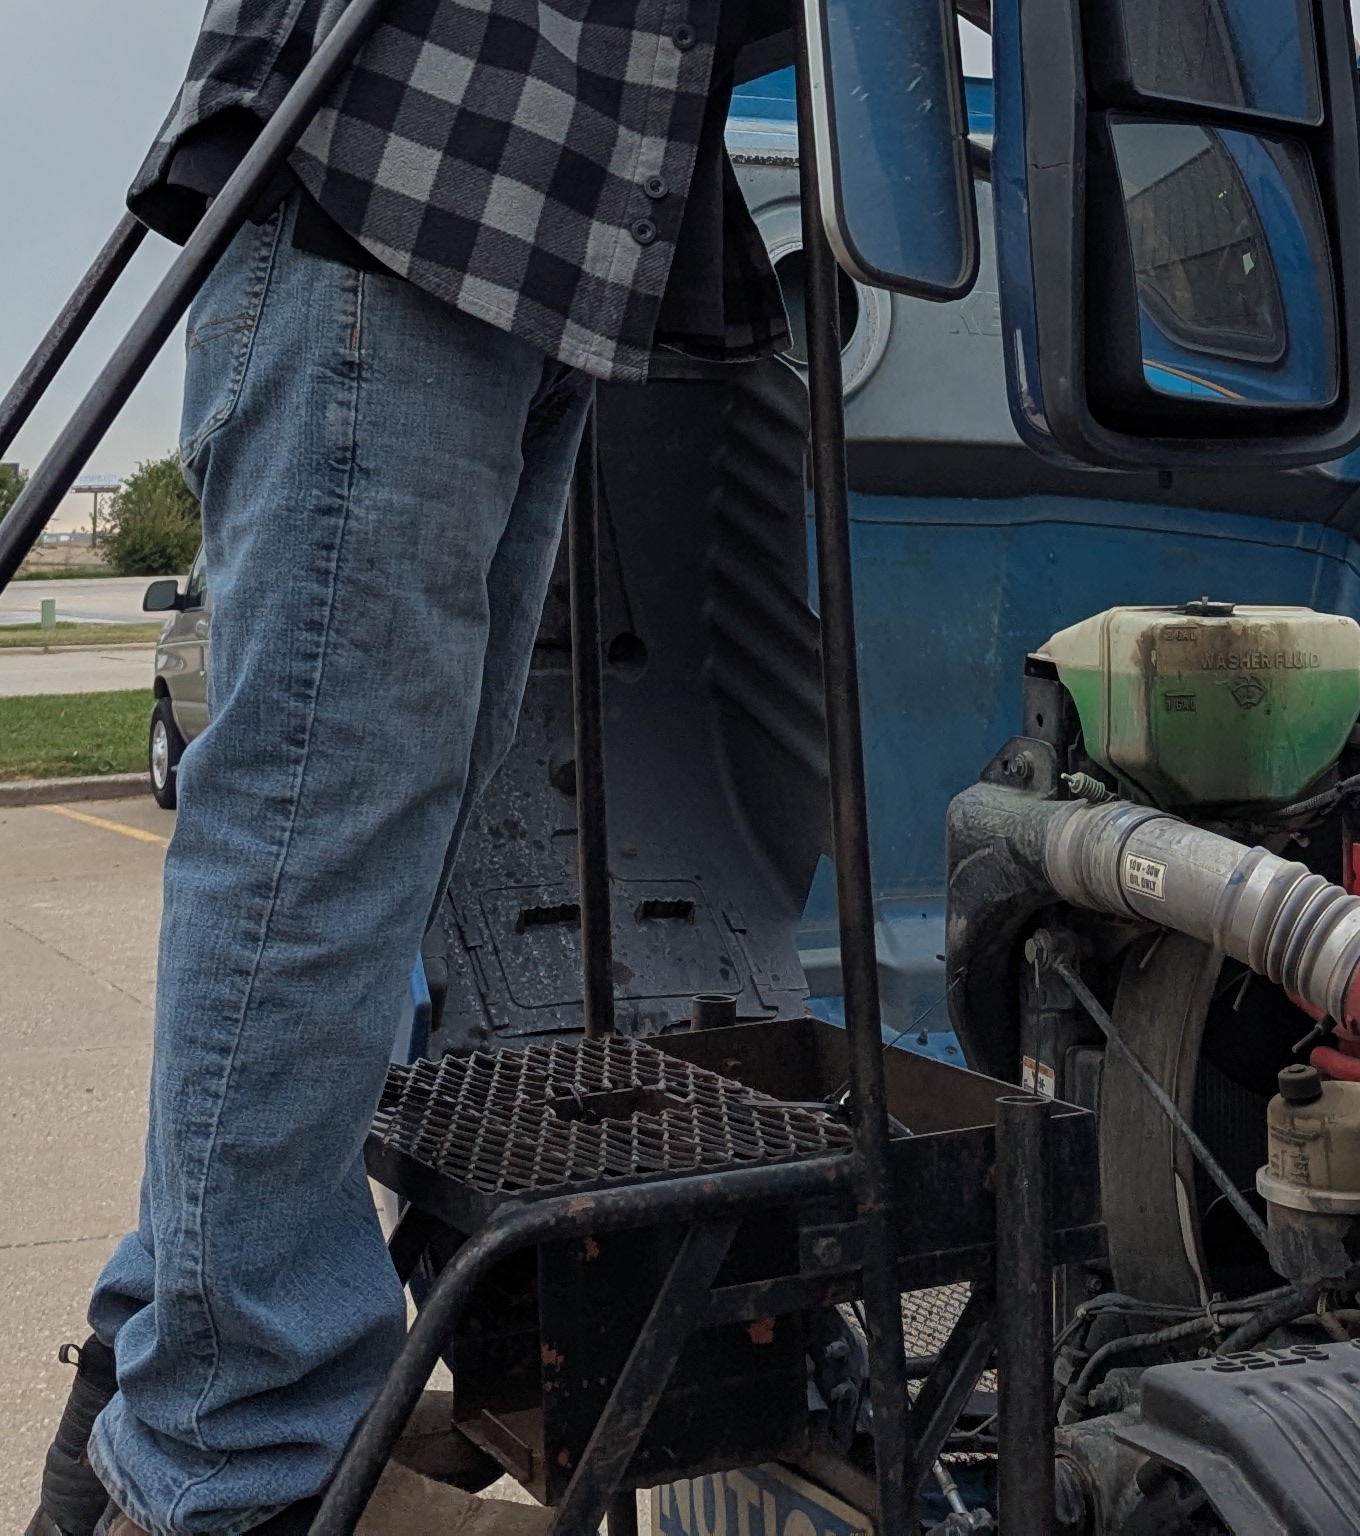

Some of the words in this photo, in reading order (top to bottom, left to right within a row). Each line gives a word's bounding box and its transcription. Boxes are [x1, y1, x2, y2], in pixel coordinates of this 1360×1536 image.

[1177, 630, 1197, 641] GAL
[1202, 651, 1271, 670] WASHER
[1275, 651, 1320, 669] FLUID
[1176, 699, 1197, 711] GAL
